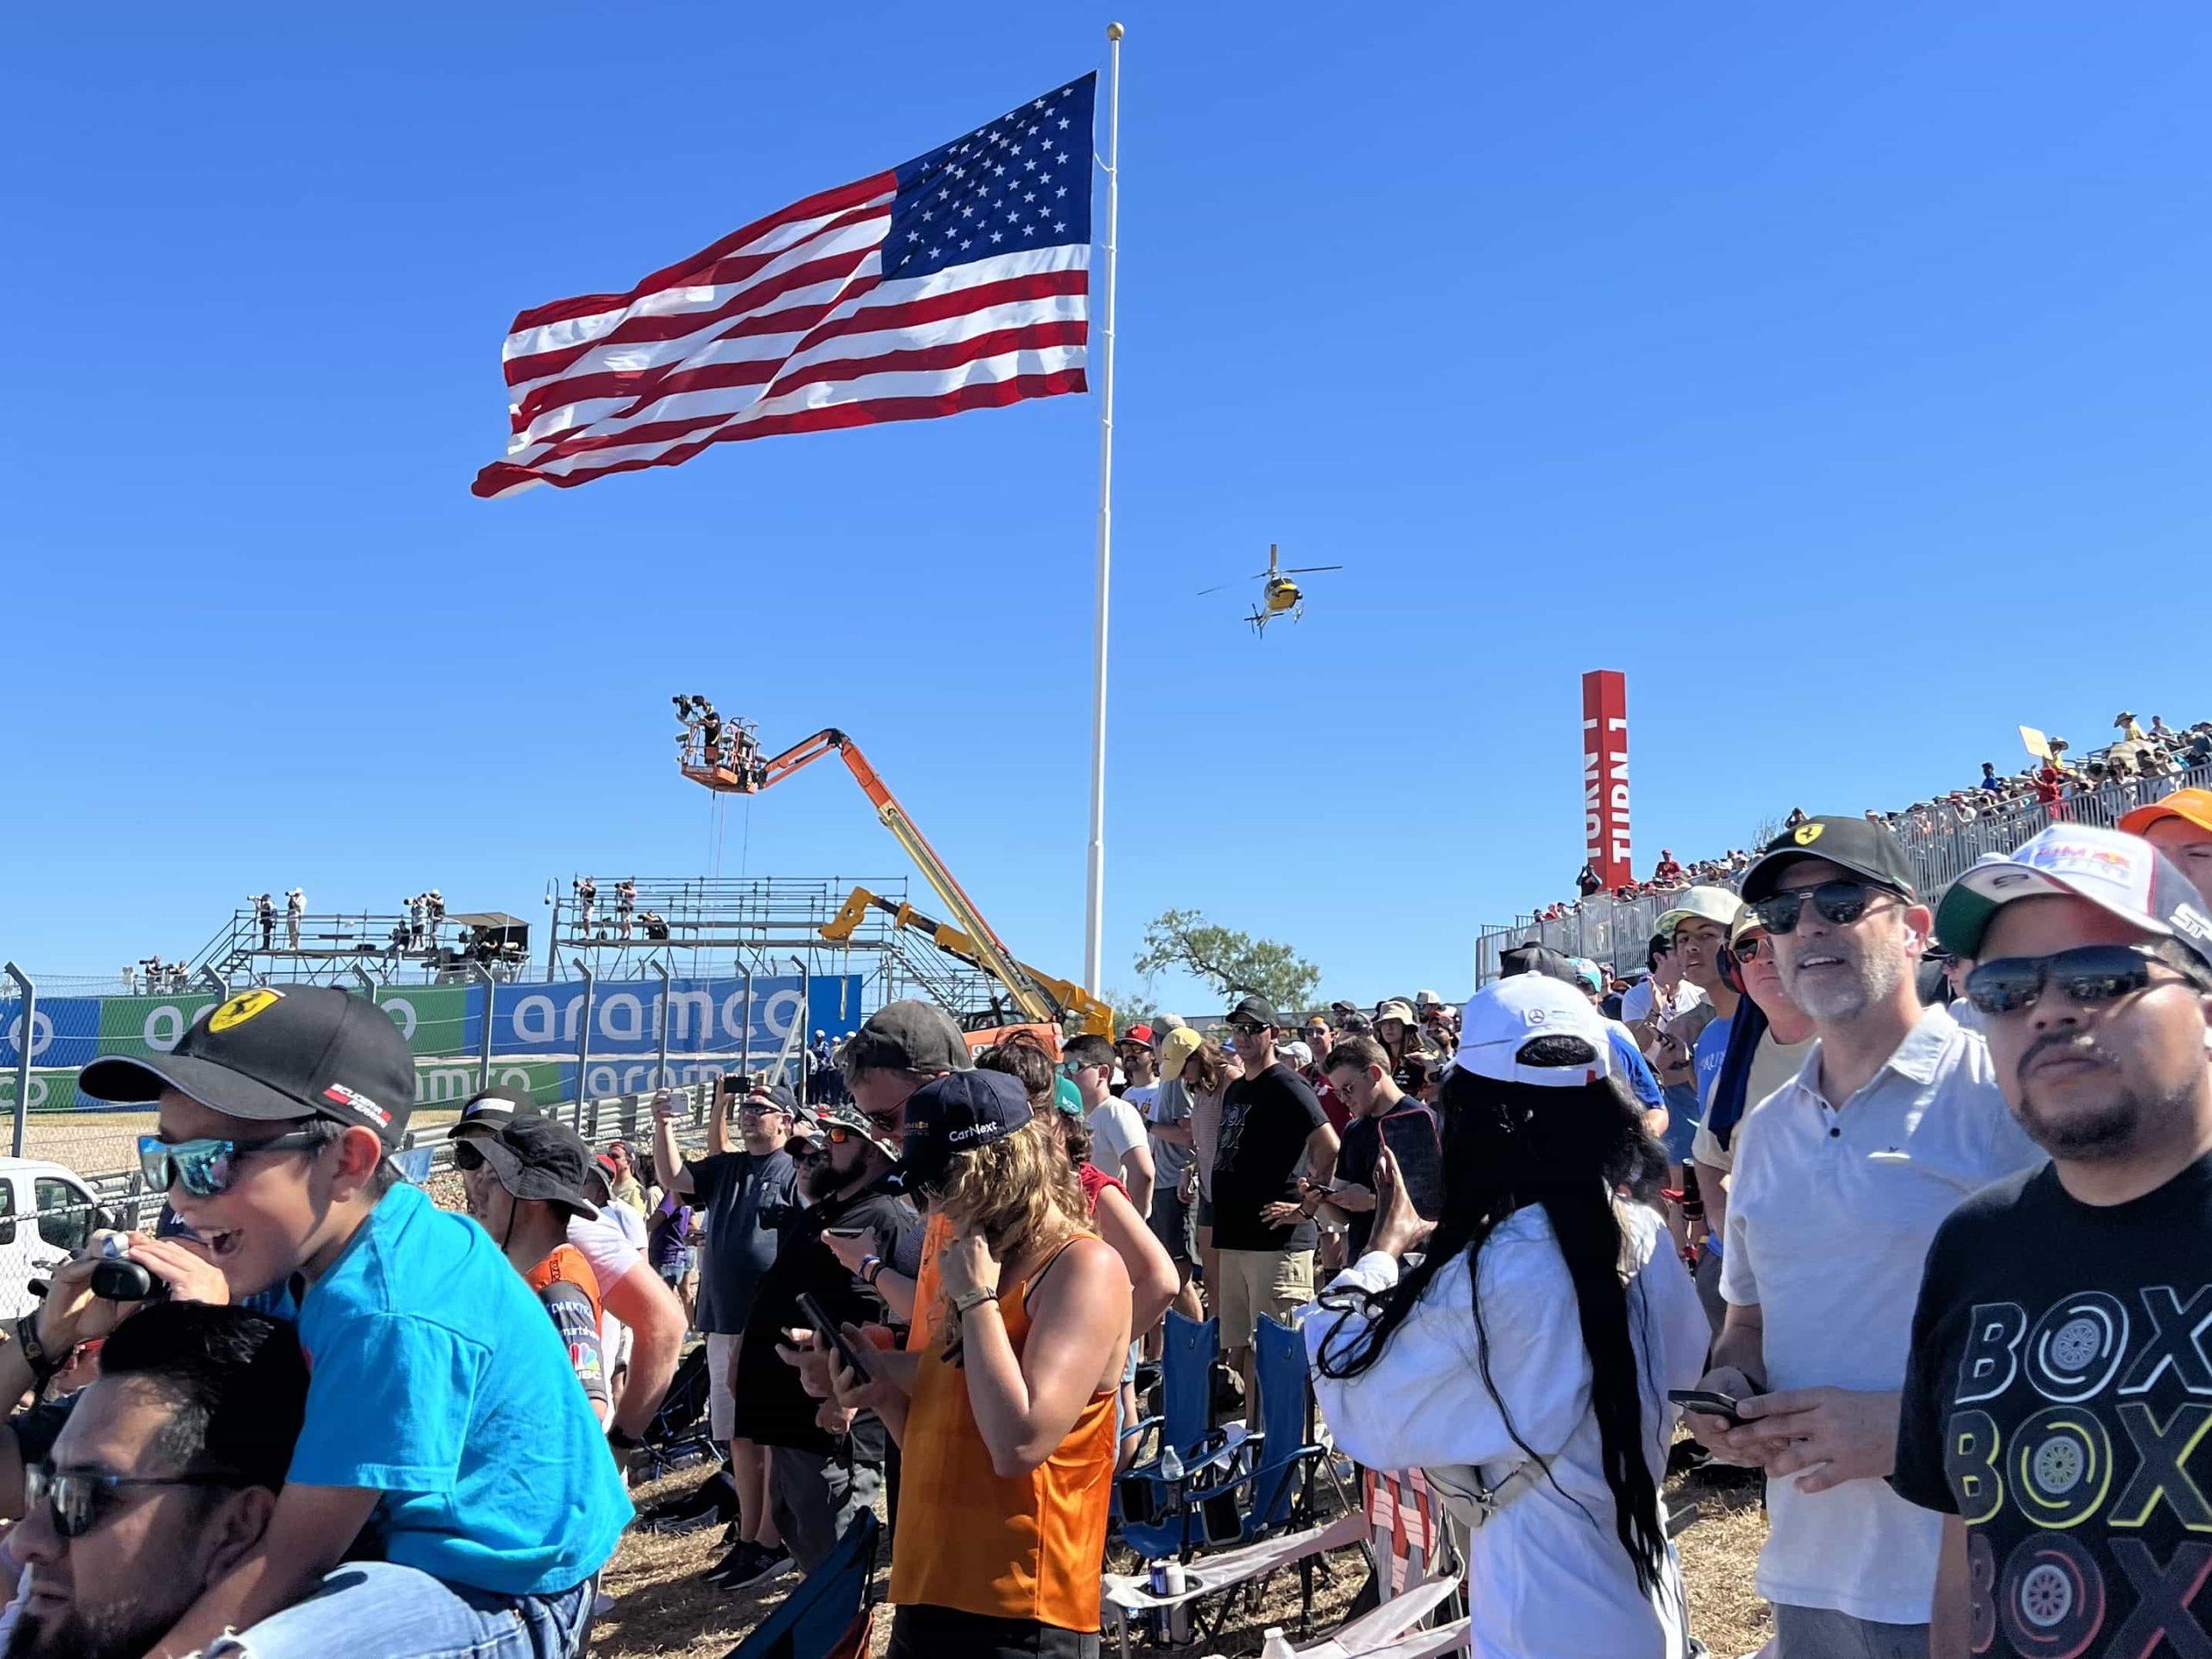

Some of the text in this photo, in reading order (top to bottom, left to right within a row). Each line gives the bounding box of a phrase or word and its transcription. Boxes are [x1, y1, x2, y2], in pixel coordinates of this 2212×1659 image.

[1608, 717, 1628, 732] 1
[512, 988, 807, 1043] aramco
[949, 1121, 998, 1141] CarNext
[1955, 1284, 2212, 1404] BOX
[1944, 1402, 2212, 1534] BOX
